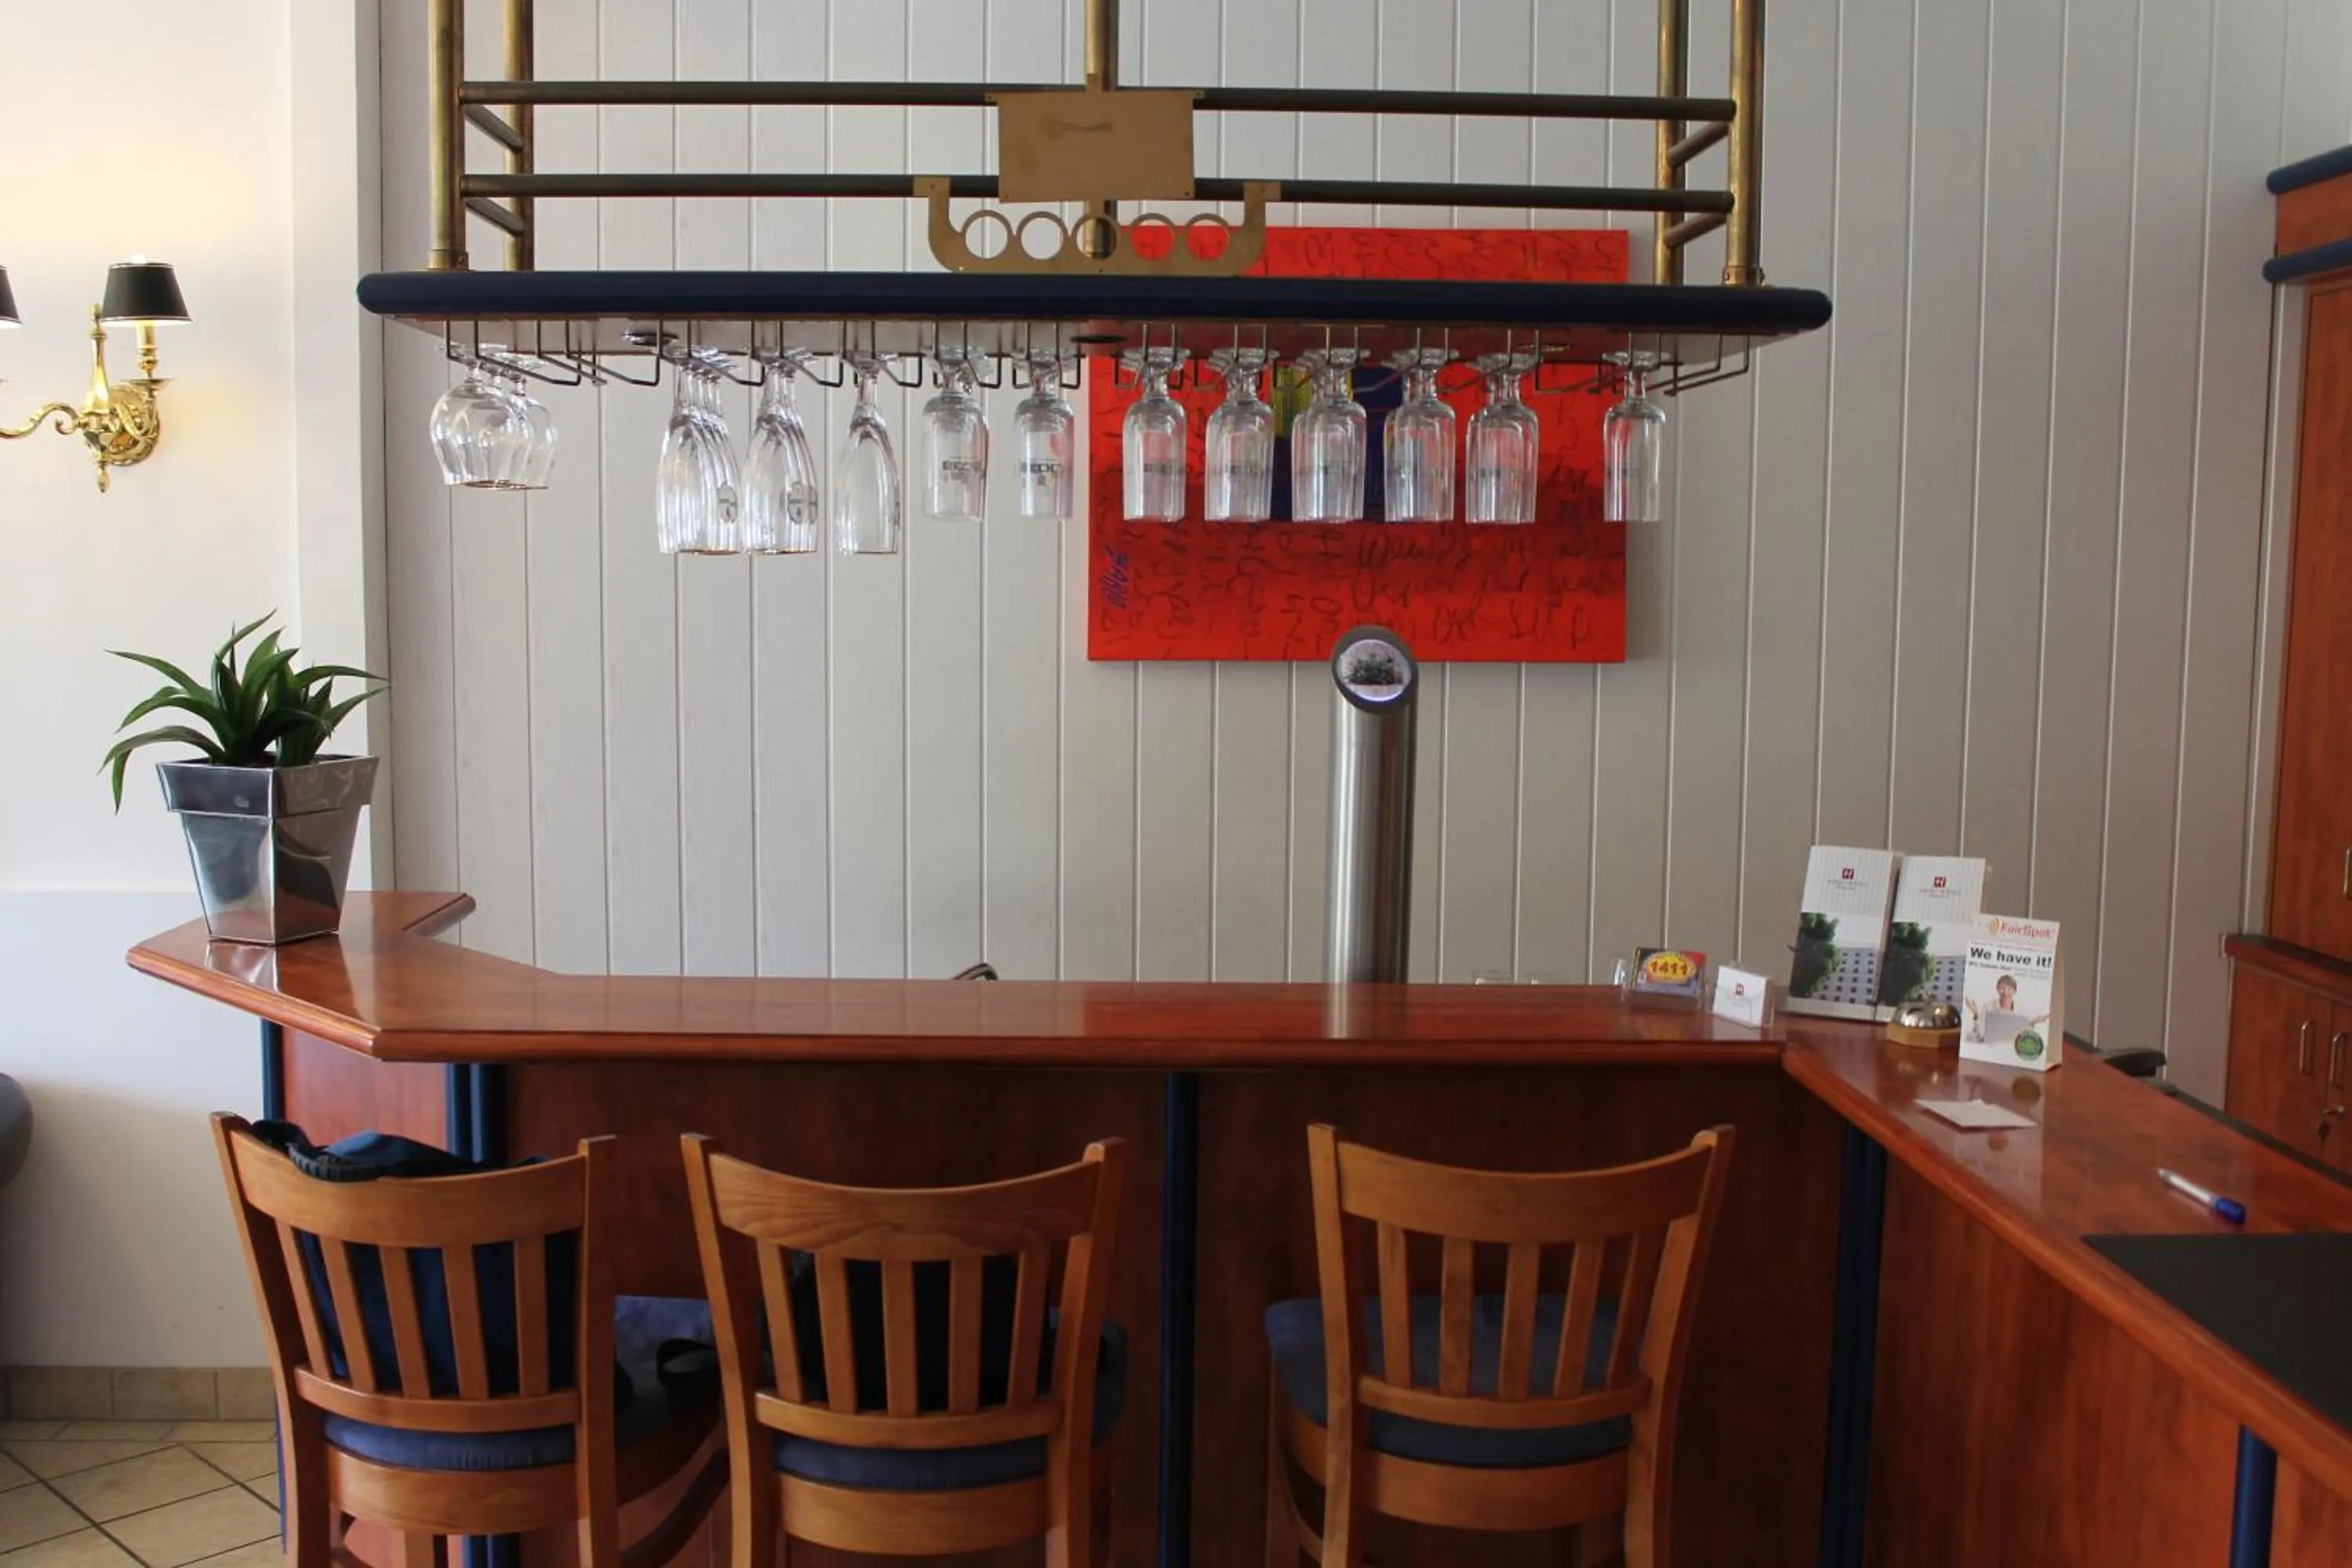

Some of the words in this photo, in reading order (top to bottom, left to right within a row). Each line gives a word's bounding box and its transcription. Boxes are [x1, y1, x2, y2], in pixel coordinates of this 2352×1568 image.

[2002, 922, 2051, 938] FairSpot
[1970, 946, 1992, 960] We
[1997, 949, 2031, 965] have
[2036, 956, 2052, 968] it!
[1650, 960, 1688, 975] 1411
